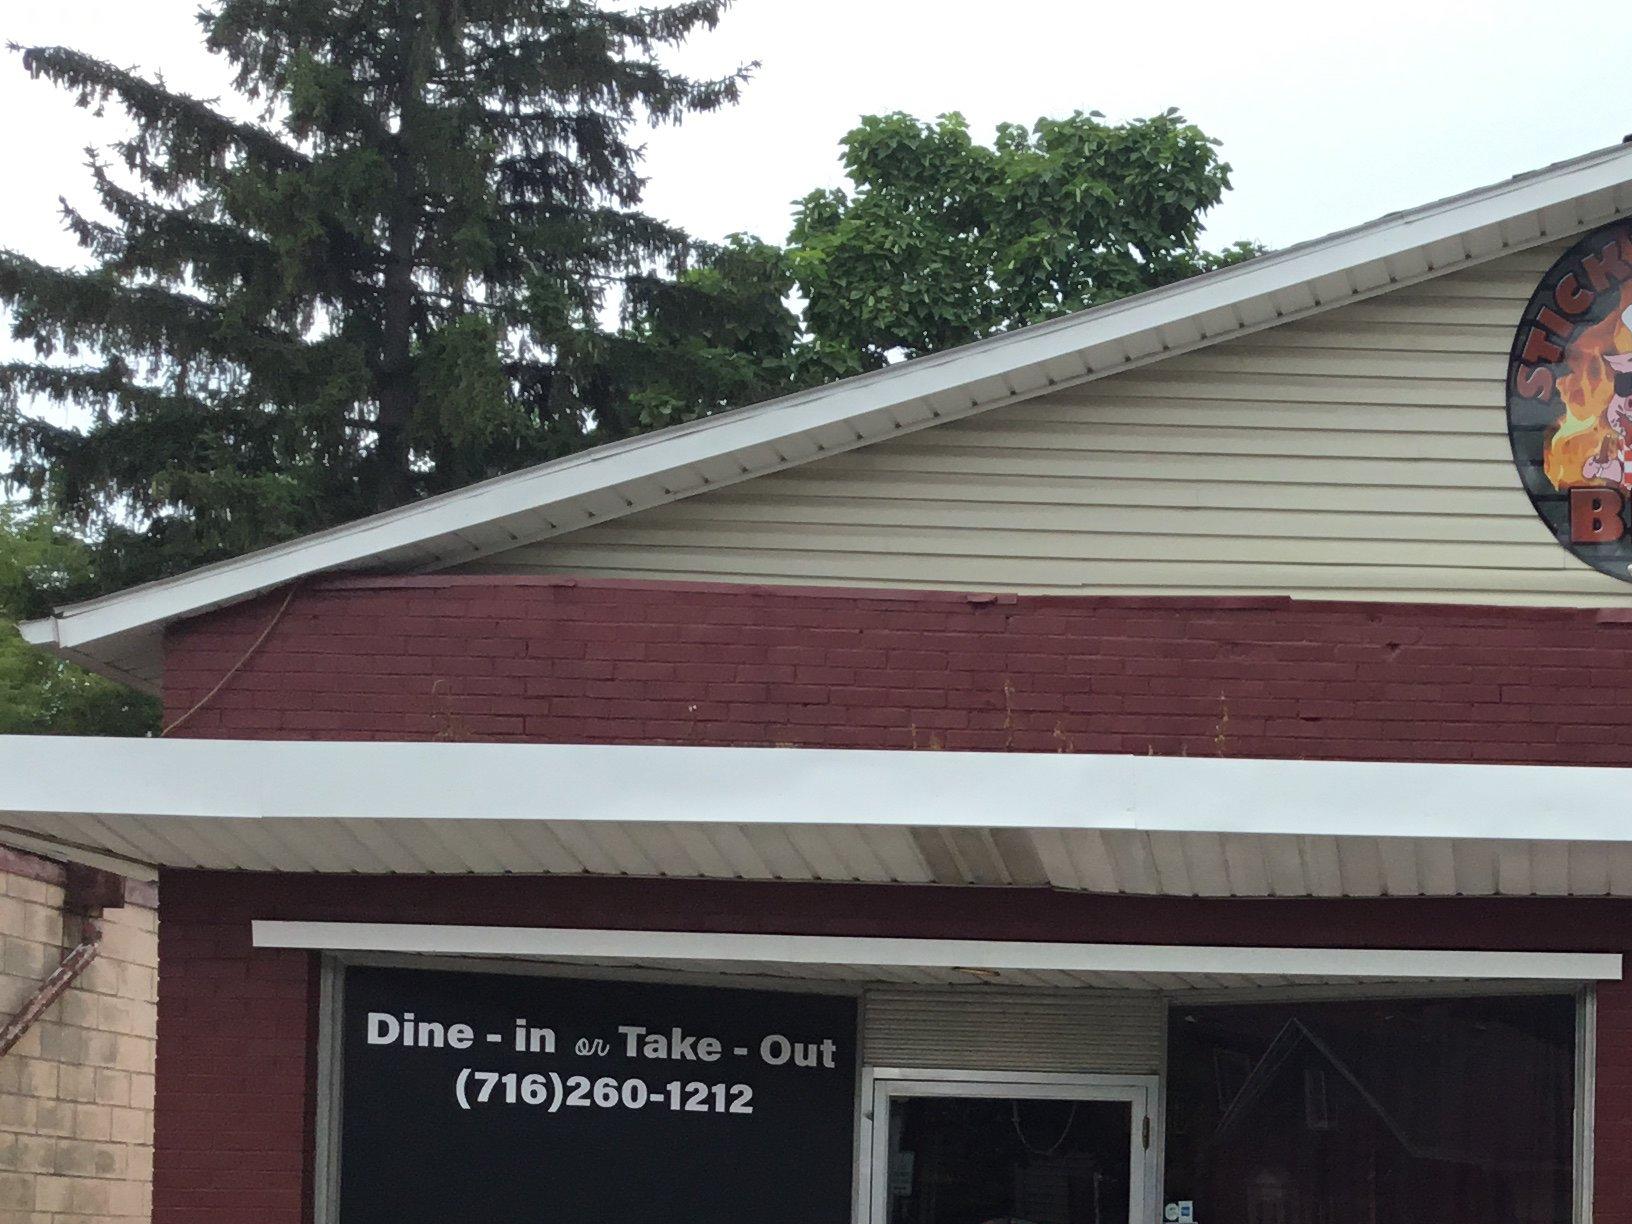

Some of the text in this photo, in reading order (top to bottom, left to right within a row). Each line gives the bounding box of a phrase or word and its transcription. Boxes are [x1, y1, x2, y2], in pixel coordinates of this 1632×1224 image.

[367, 1012, 474, 1049] Dine
[515, 1019, 556, 1054] in
[574, 1036, 610, 1057] or
[618, 1026, 722, 1062] Take
[760, 1034, 837, 1069] Out
[455, 1068, 754, 1113] (716)260-1212
